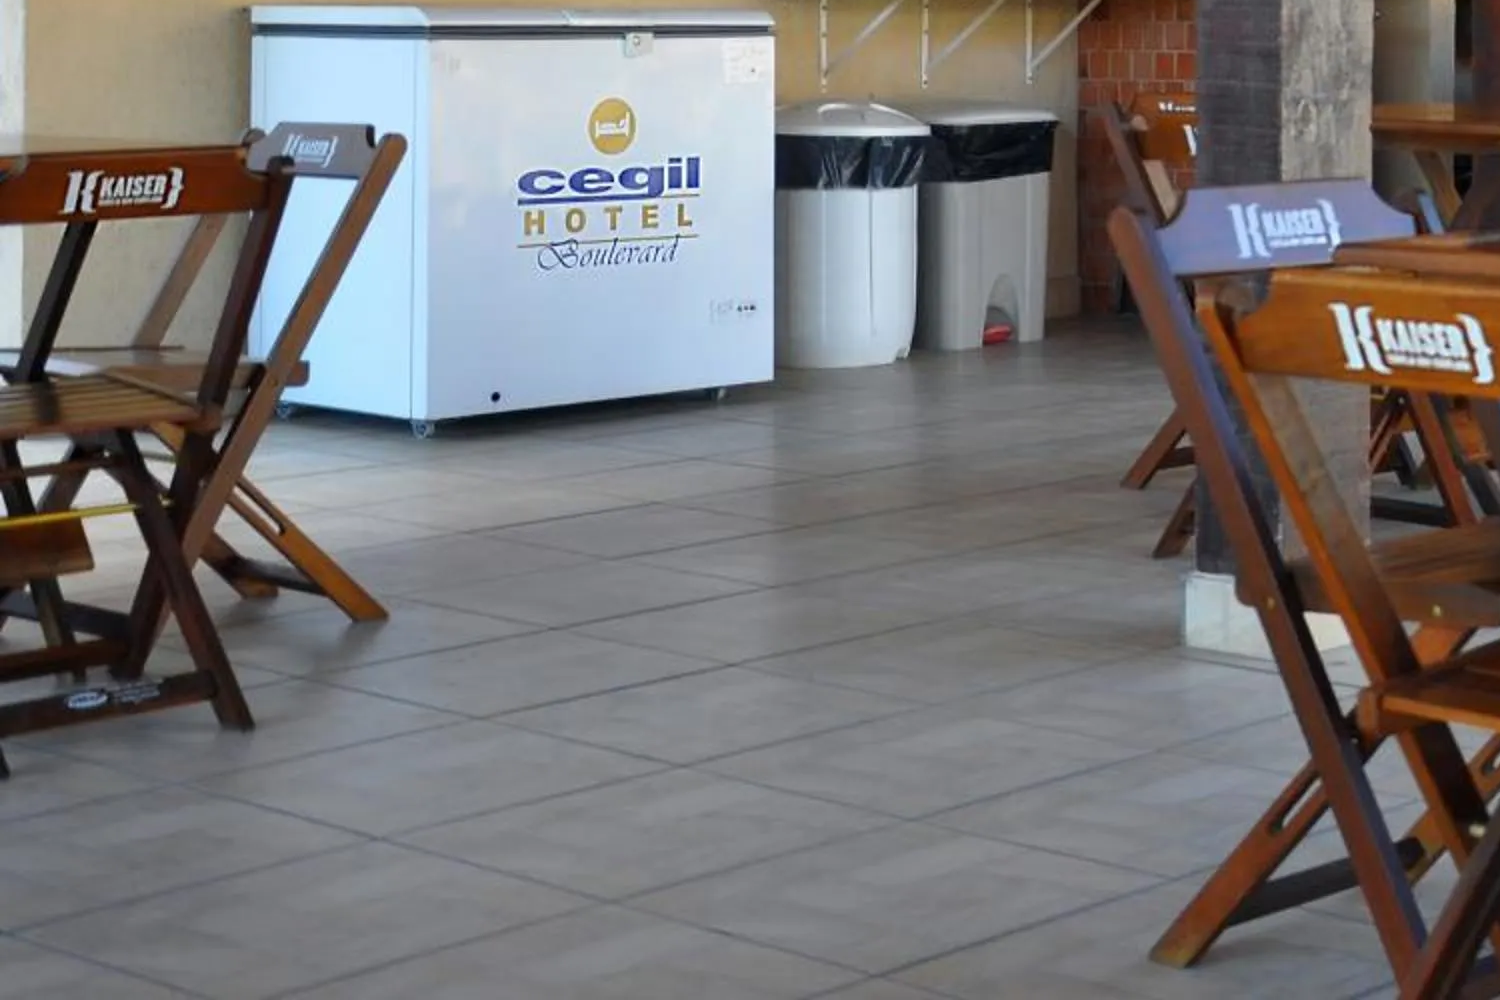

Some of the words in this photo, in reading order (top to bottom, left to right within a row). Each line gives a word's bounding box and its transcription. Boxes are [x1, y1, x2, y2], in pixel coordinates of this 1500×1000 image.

[99, 174, 168, 199] KAISER
[517, 156, 700, 206] cegil
[523, 203, 693, 237] HOTEL
[537, 234, 681, 271] Boulevard
